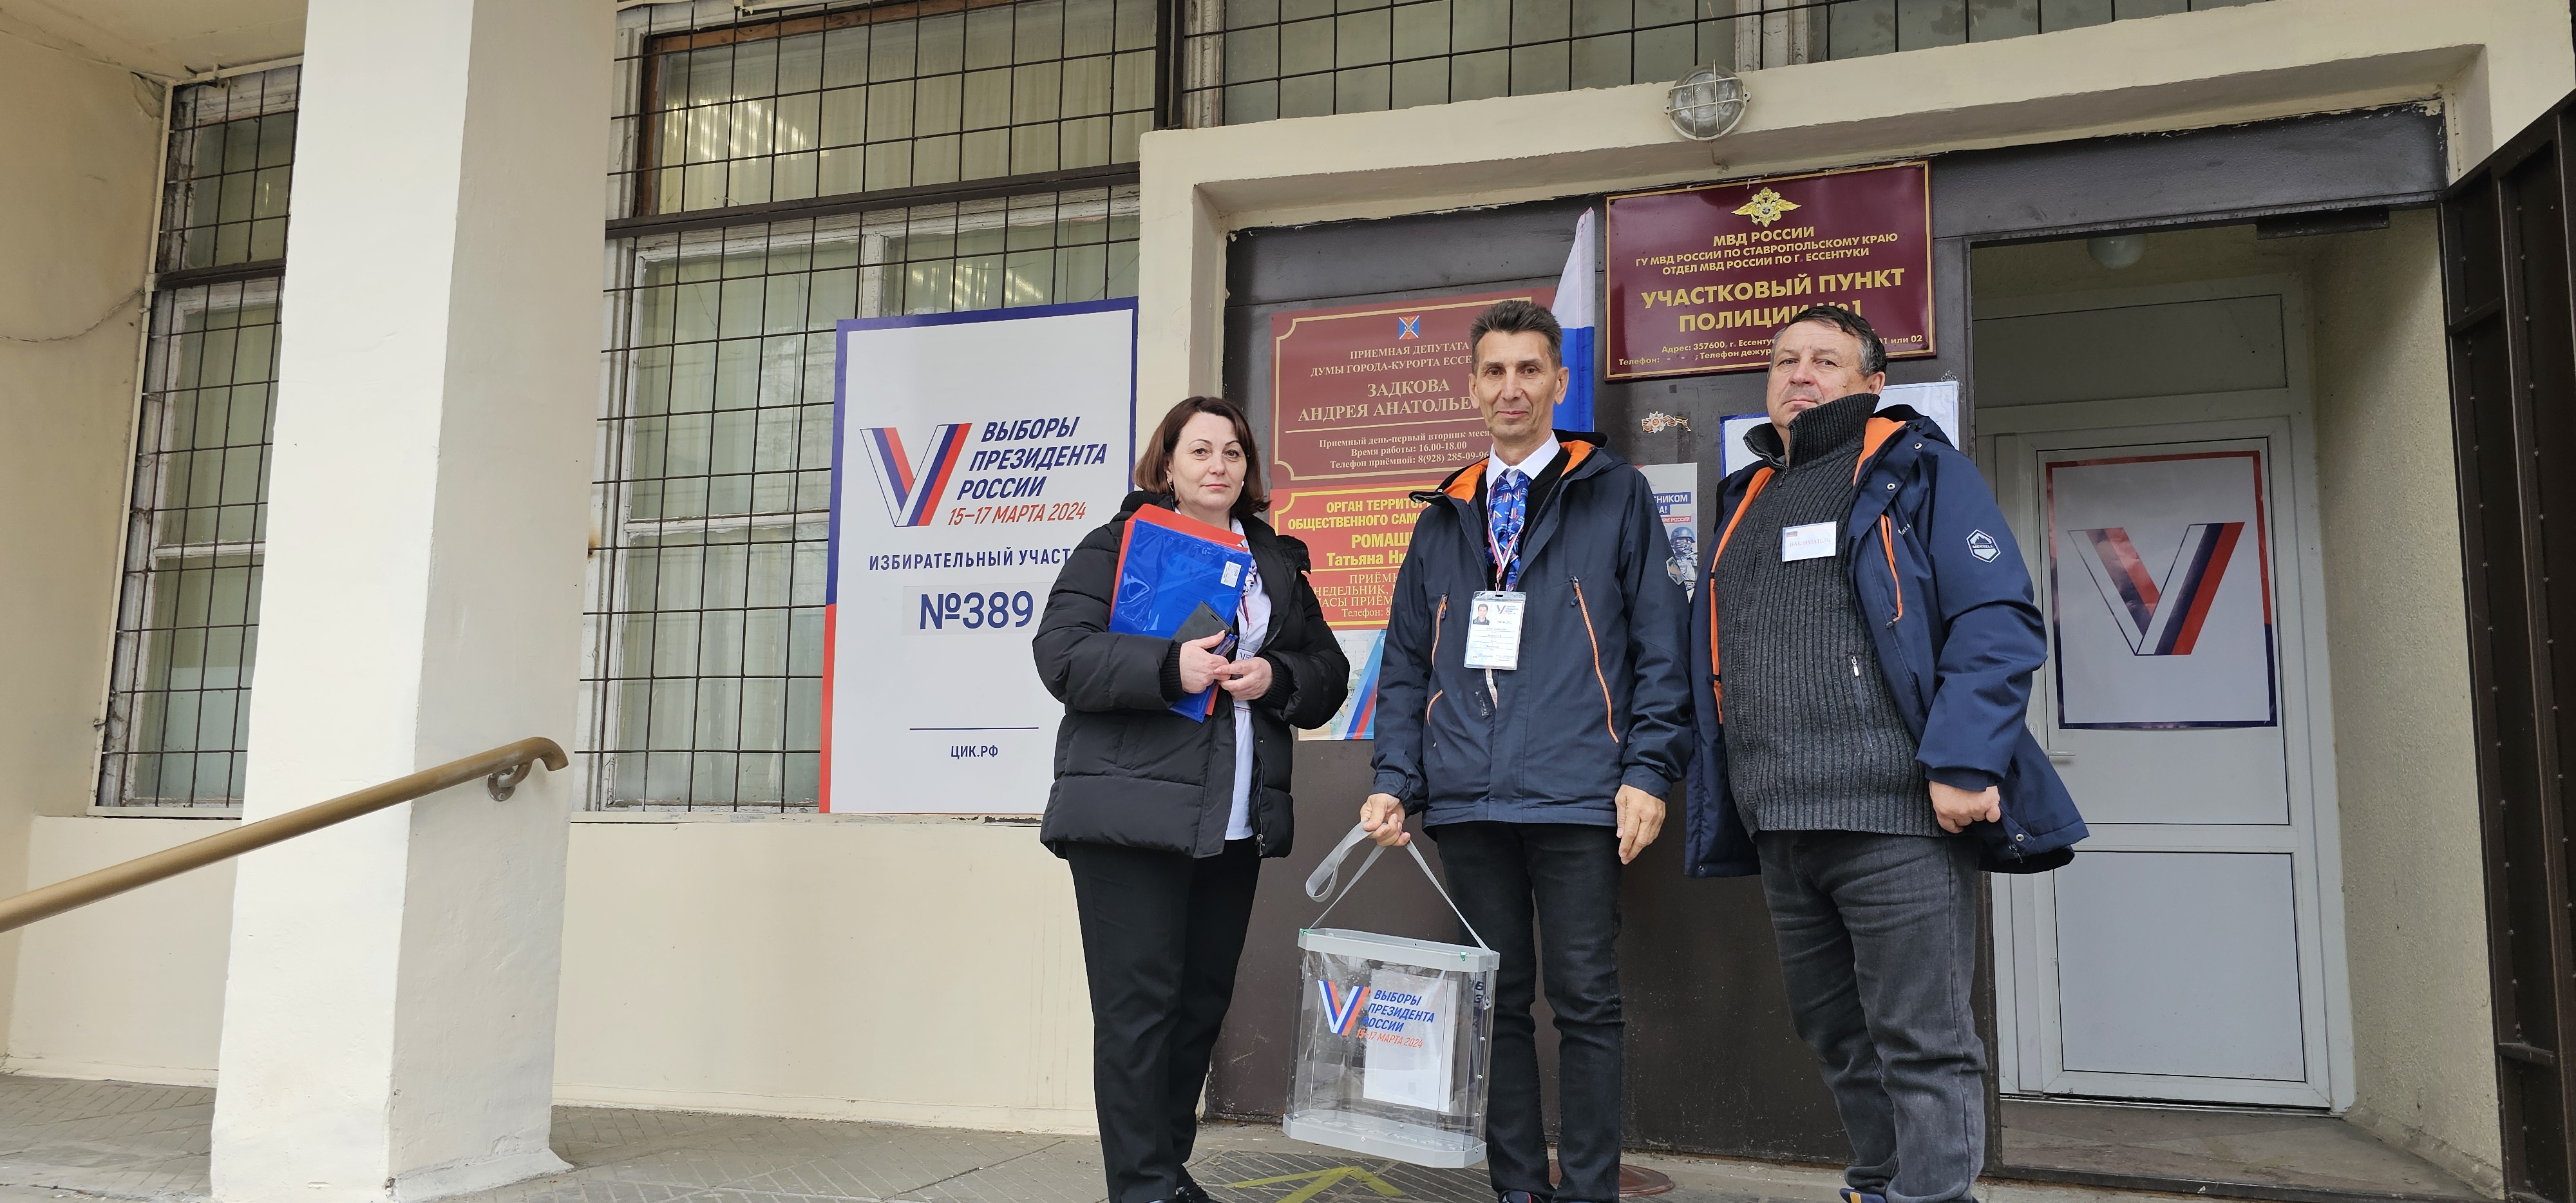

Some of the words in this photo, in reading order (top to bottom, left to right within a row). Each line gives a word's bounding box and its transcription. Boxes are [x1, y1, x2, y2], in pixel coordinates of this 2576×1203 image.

[1713, 234, 1748, 247] МВД
[1751, 226, 1814, 243] РОССИИ
[1636, 258, 1648, 267] ГУ
[1650, 256, 1674, 265] МВД
[1676, 251, 1721, 262] РОССИИ
[1724, 249, 1741, 258] ПО
[1743, 236, 1860, 256] СТАВРОПОЛЬСКОМУ
[1862, 232, 1898, 245] КРАЮ
[1662, 265, 1698, 275] ОТДЕЛ
[1700, 261, 1725, 271] МВД
[1727, 258, 1772, 269] РОССИИ
[1775, 255, 1792, 265] ПО
[1806, 248, 1870, 261] ЕССЕНТУКИ
[1641, 273, 1811, 309] УЧАСТКОВЫЙ
[1819, 268, 1905, 293] ПУНКТ
[1680, 304, 1810, 332] ПОЛИЦИИ
[1350, 346, 1410, 359] ПРИЕМНАЯ
[1412, 341, 1470, 355] ДЕПУТАТА
[1619, 358, 1660, 366] Телефон:
[1700, 351, 1739, 360] Телефон
[1662, 345, 1691, 354] Адрес:
[1311, 366, 1345, 377] ДУМЫ
[1347, 358, 1441, 374] ГОРОДА-КУРОРТА
[1367, 378, 1450, 398] ЗАДКОВА
[1298, 404, 1369, 422] АНДРЕЯ
[1373, 395, 1475, 417] АНАТОЛЬЕ
[981, 417, 1080, 442] ВЫБОРЫ
[1320, 437, 1367, 448] Приемный
[1368, 433, 1426, 445] день-первый
[1428, 430, 1466, 441] вторник
[1468, 429, 1493, 438] меся
[969, 443, 1108, 472] ПРЕЗИДЕНТА
[1351, 448, 1379, 458] Время
[1381, 445, 1416, 455] работы:
[1419, 440, 1467, 452] 16.00-18.00
[1330, 459, 1367, 469] Телефон
[1368, 456, 1416, 467] приёмной:
[1418, 453, 1445, 464] 8(928)
[1447, 450, 1489, 462] 285-09-96
[957, 475, 1047, 500] РОССИИ
[1326, 500, 1363, 513] ОРГАН
[1653, 494, 1688, 504] НИКОМ
[992, 504, 1045, 524] МАРТА
[1046, 501, 1086, 521] 2024
[1658, 506, 1667, 514] А!
[1288, 514, 1388, 531] ОБЩЕСТВЕННОГО
[1789, 537, 1830, 547] НАБЛЮДАТЕЛЬ
[869, 546, 1013, 571] ИЗБИРАТЕЛЬНЫЙ
[1326, 552, 1383, 566] Татьяна
[920, 591, 1034, 630] №389
[1341, 609, 1383, 618] Телефон:
[951, 745, 998, 759] ЦИК.РФ
[1374, 989, 1422, 1006] ВЫБОРЫ
[1368, 1003, 1435, 1023] ПРЕЗИДЕНТА
[1361, 1015, 1404, 1032] РОССИИ
[1377, 1032, 1403, 1045] МАРТА
[1403, 1037, 1423, 1048] 2024
